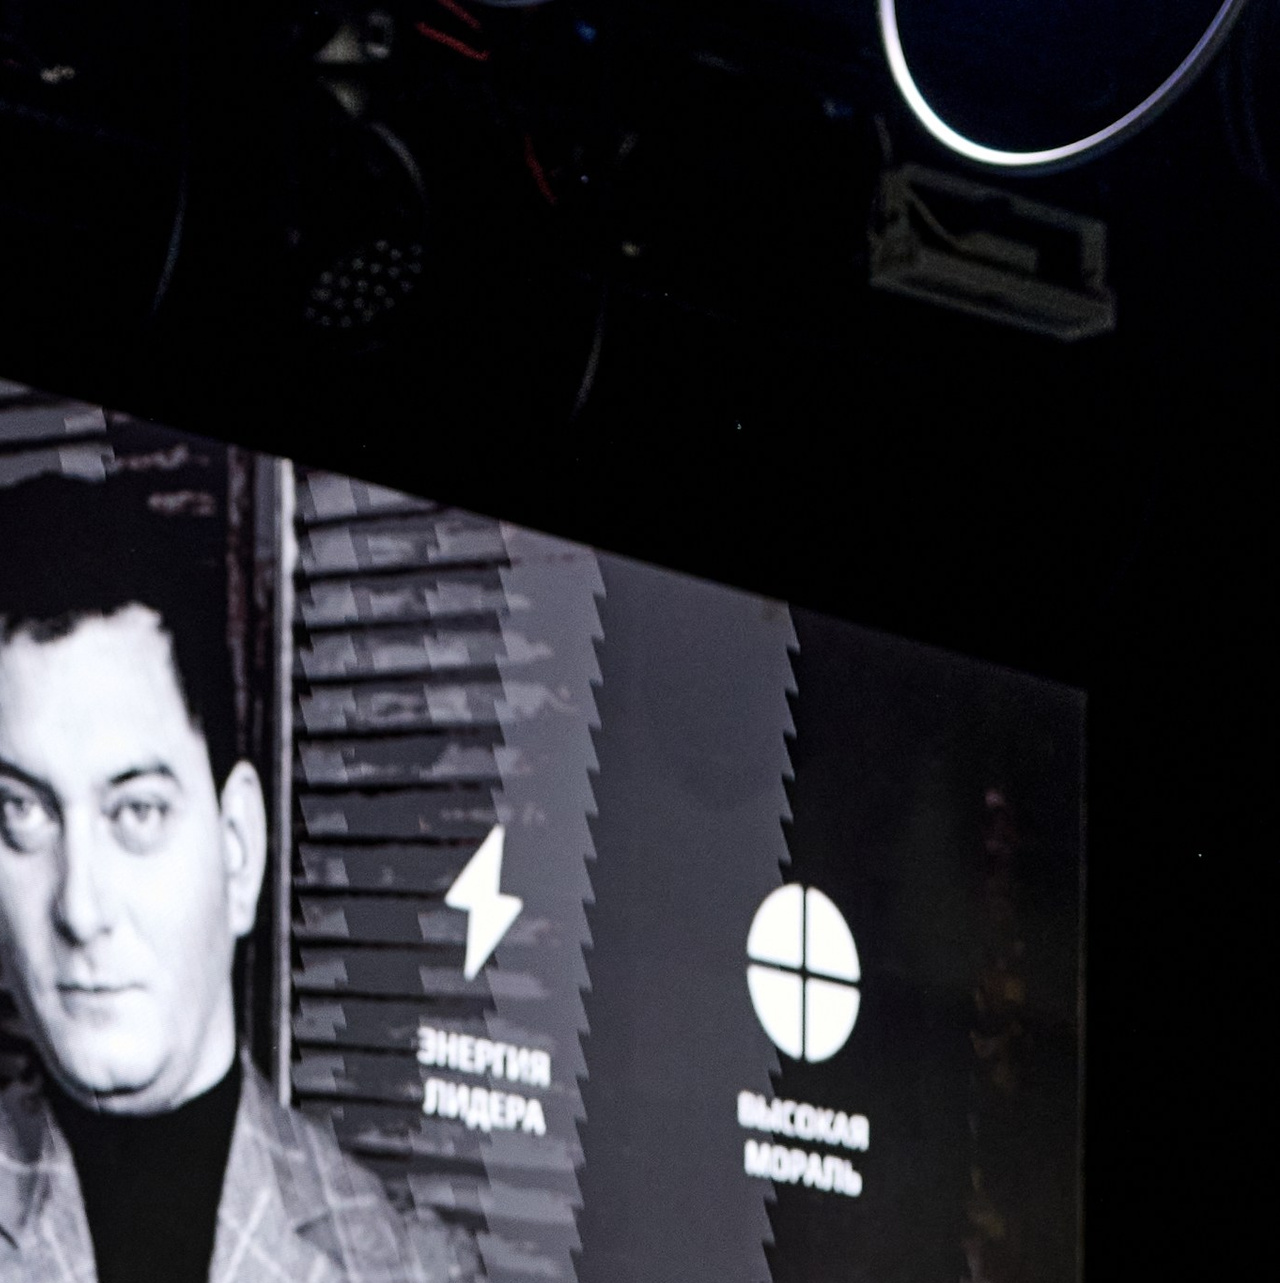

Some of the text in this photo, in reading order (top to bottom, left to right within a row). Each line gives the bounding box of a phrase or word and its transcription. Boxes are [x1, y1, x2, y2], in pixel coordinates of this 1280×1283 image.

[422, 1078, 546, 1136] ЛИДЕРА
[738, 1090, 871, 1152] ВЫСОКАЯ
[744, 1139, 863, 1198] МОРАЛЬ
